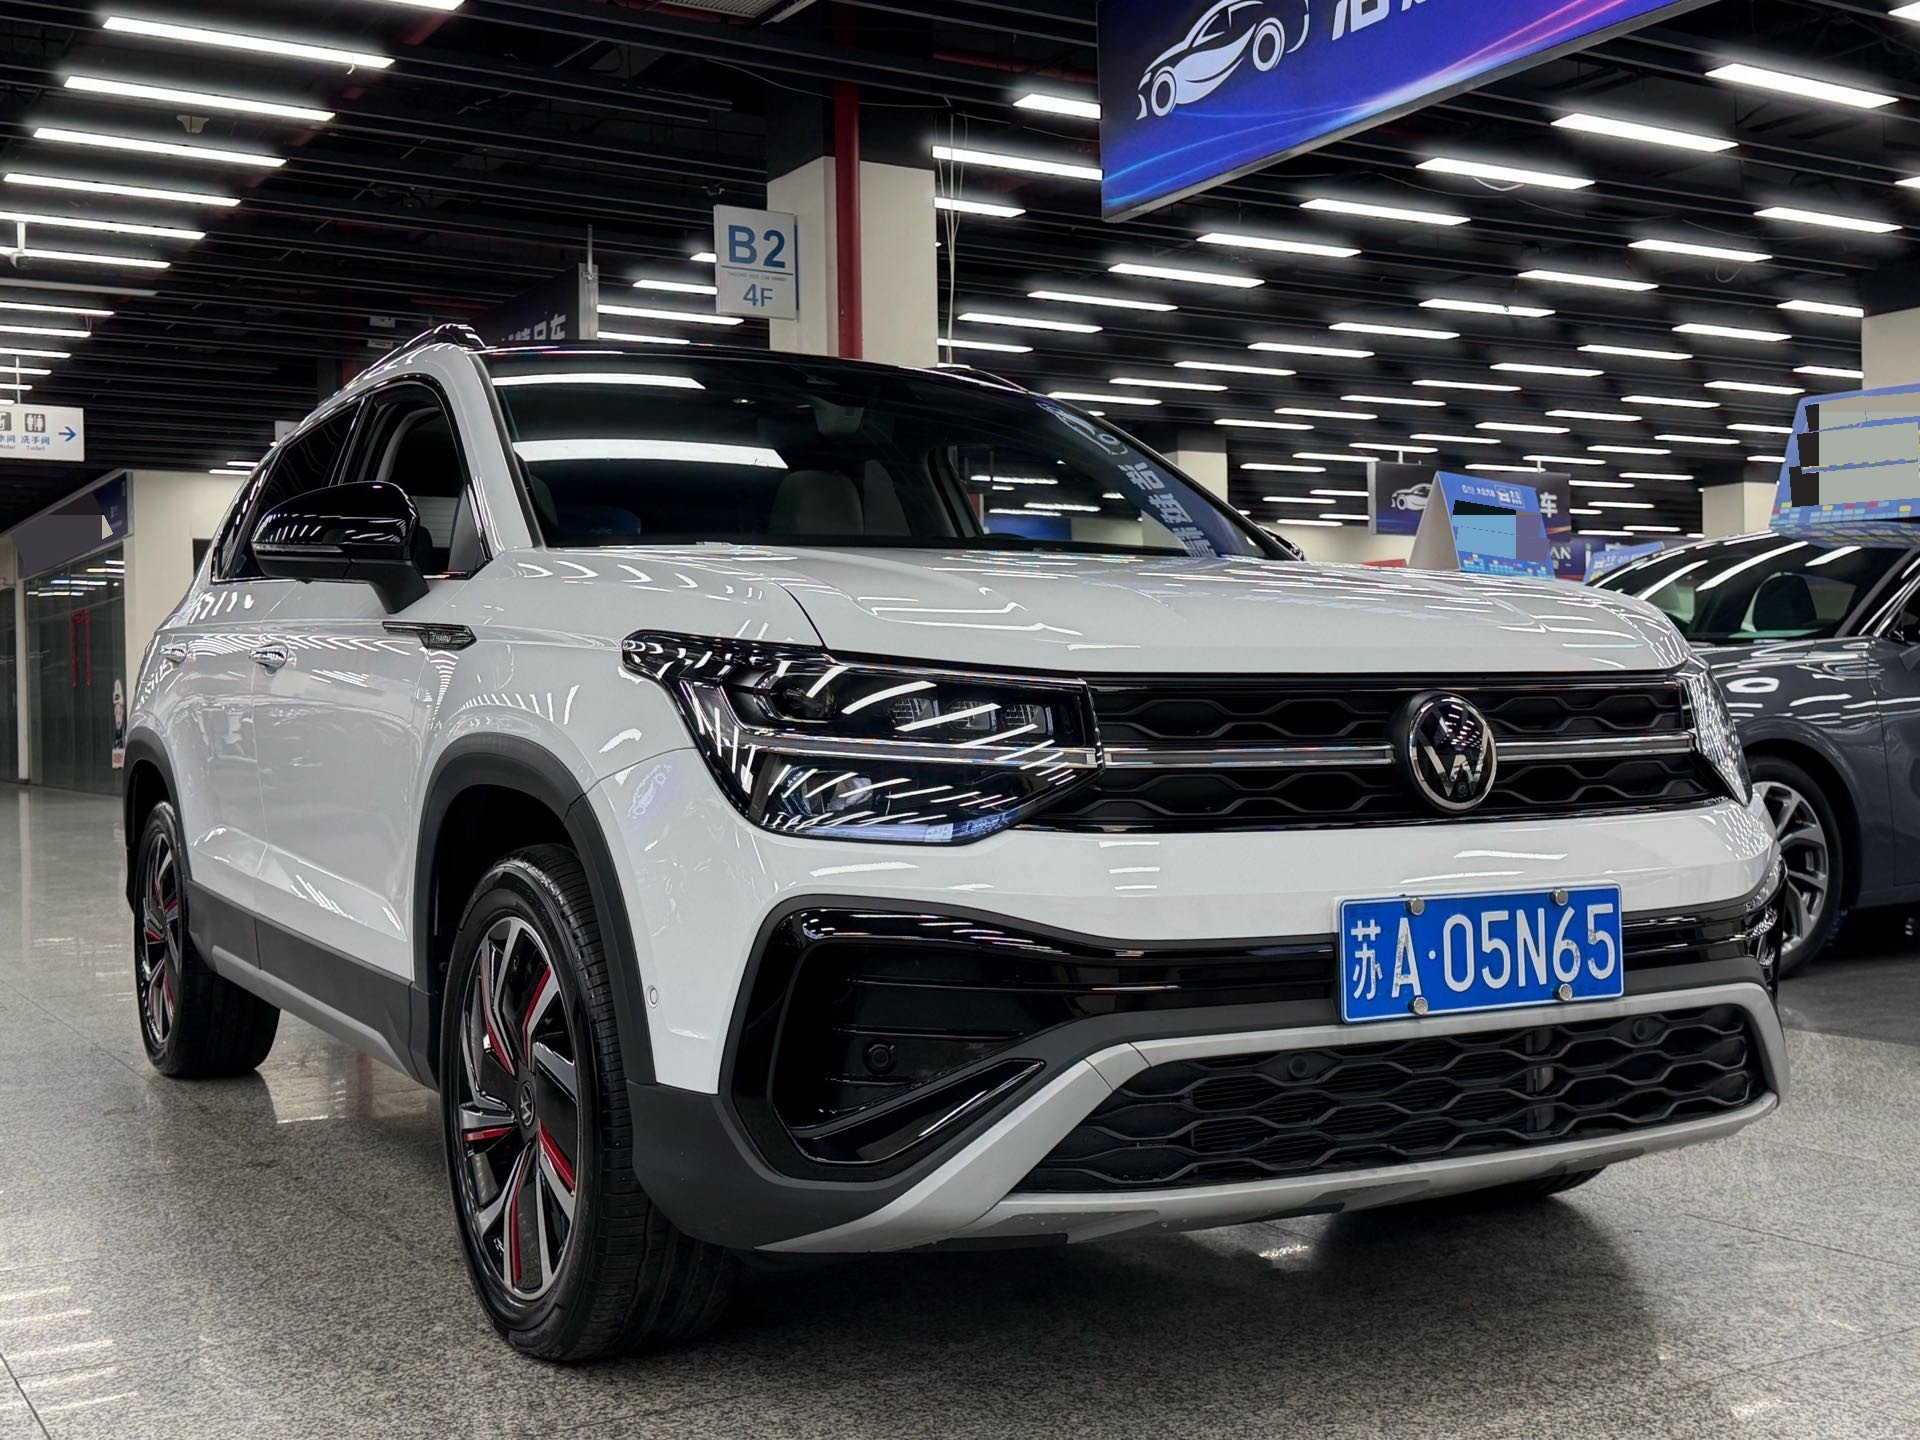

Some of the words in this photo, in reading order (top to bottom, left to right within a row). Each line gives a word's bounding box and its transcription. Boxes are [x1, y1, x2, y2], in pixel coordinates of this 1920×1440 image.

[728, 224, 785, 268] B2
[743, 283, 773, 307] 4F
[22, 435, 50, 445] 洗手间
